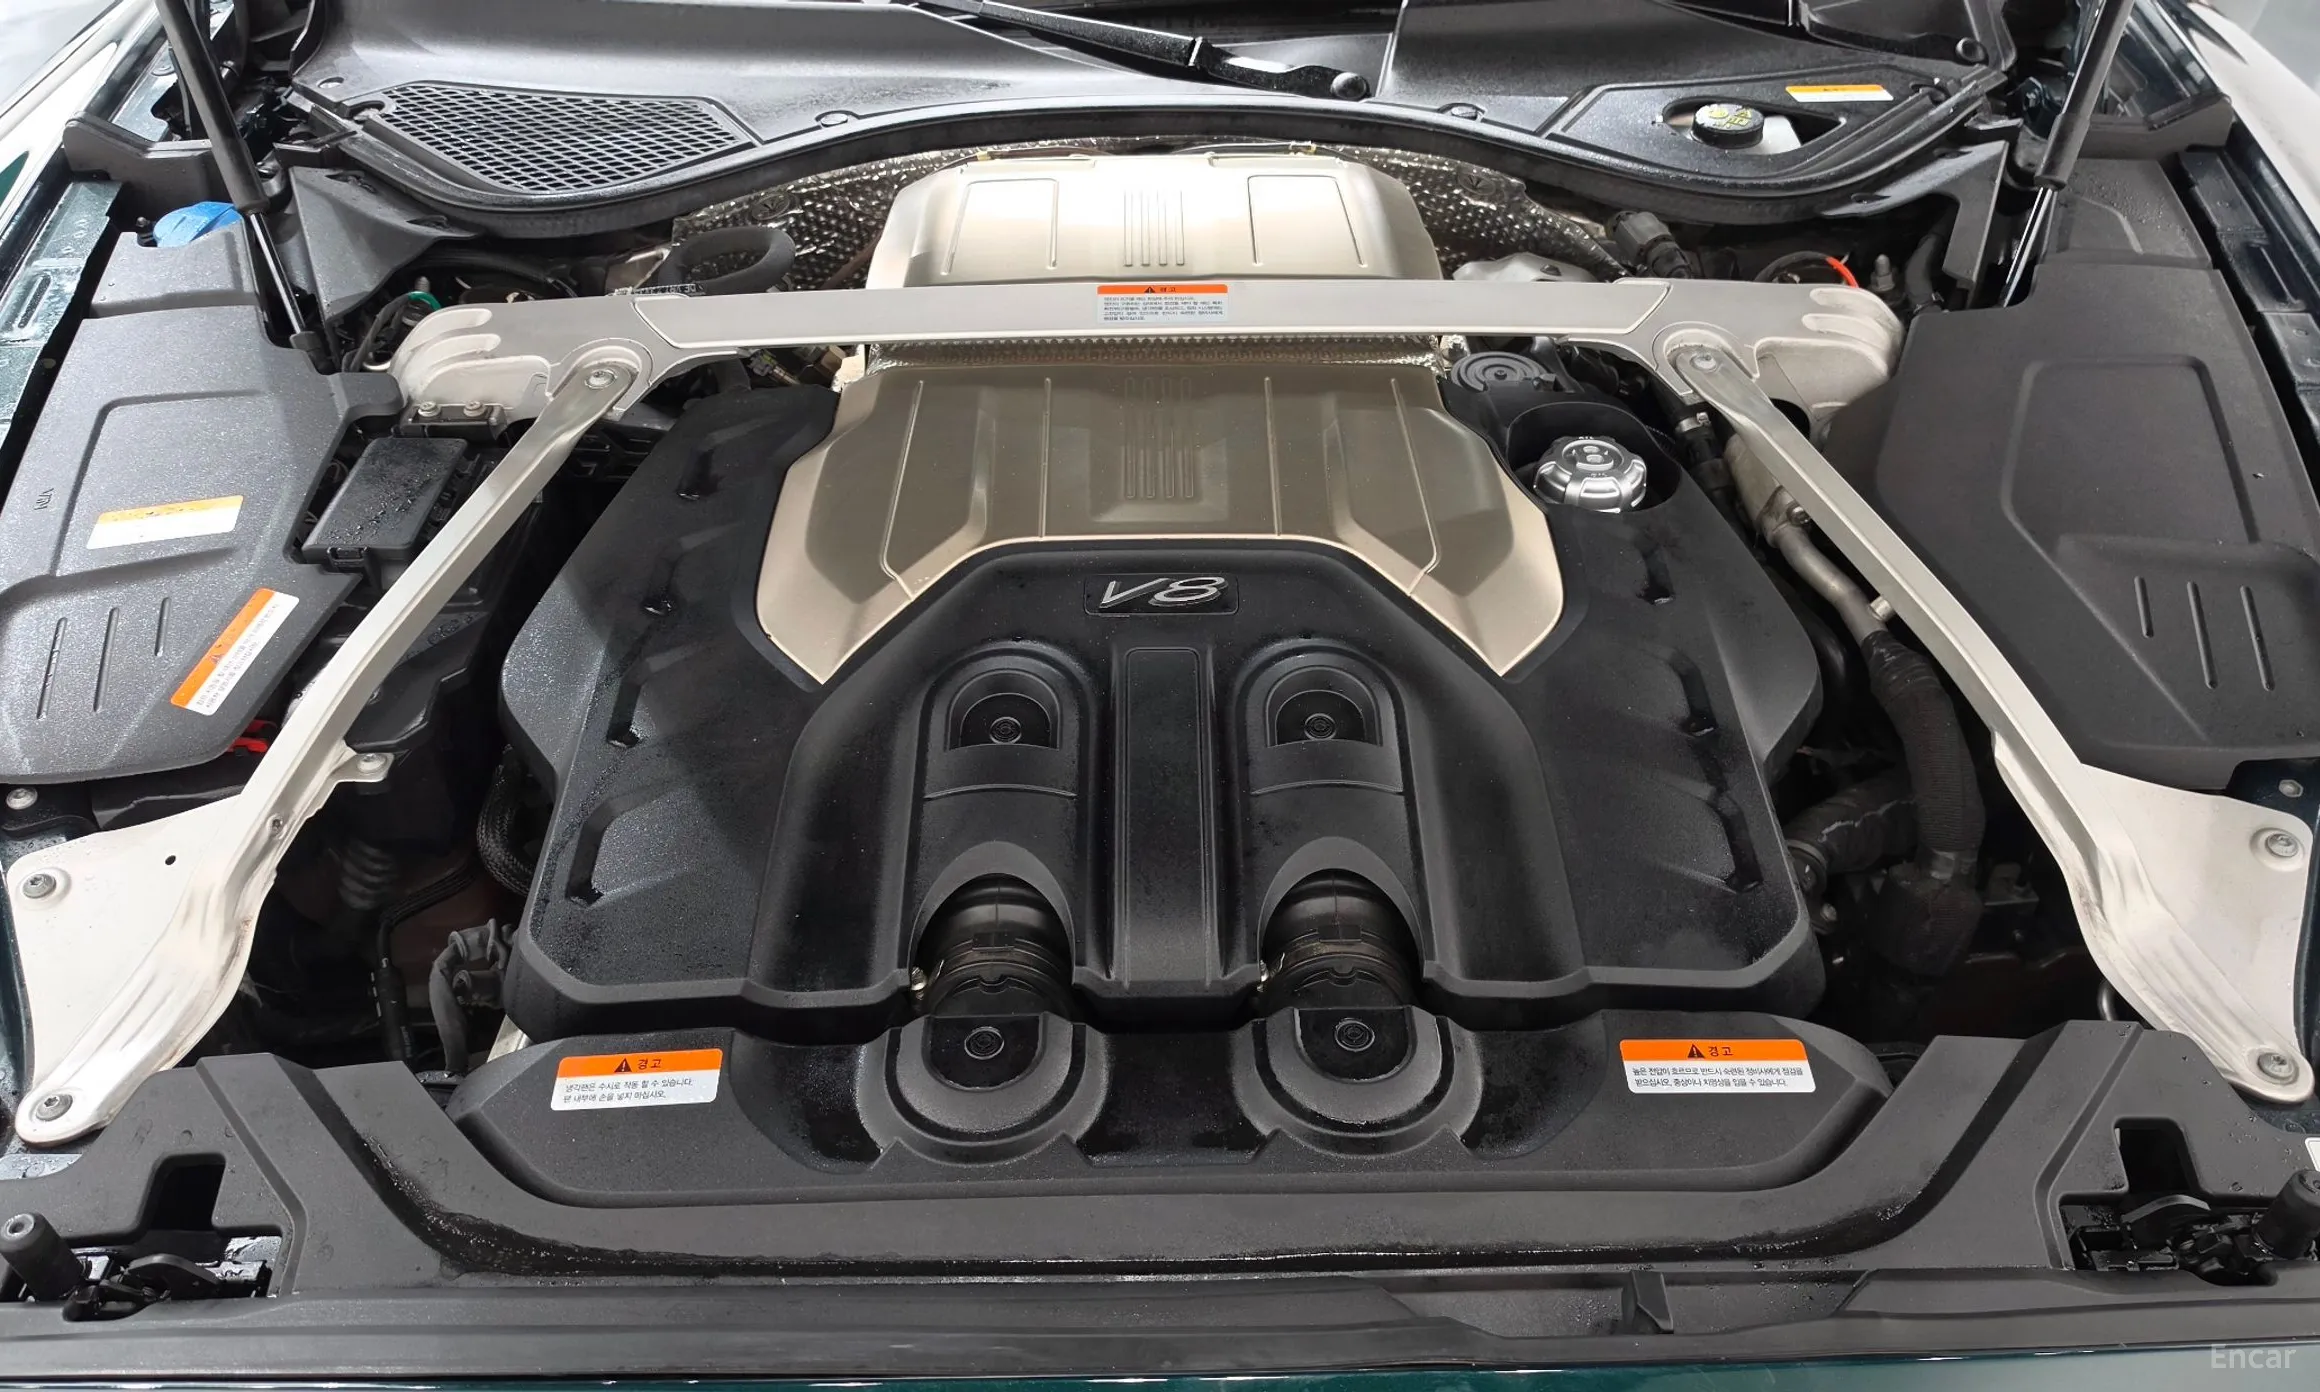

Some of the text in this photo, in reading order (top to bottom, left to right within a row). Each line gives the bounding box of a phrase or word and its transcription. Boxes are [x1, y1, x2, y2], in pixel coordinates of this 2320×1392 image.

[1099, 576, 1228, 609] V8
[1708, 1046, 1734, 1057] 경고
[638, 1058, 662, 1070] 경고
[1648, 1067, 1671, 1076] 전압이
[1700, 1067, 1722, 1076] 반드시
[599, 1081, 621, 1091] 수시로
[624, 1080, 639, 1090] 작동
[651, 1079, 660, 1087] 수
[661, 1077, 694, 1088] 있습니다.
[1748, 1079, 1756, 1087] 수
[1757, 1078, 1788, 1087] 있습니다.
[599, 1092, 615, 1102] 손을
[634, 1090, 666, 1100] 마십시오.
